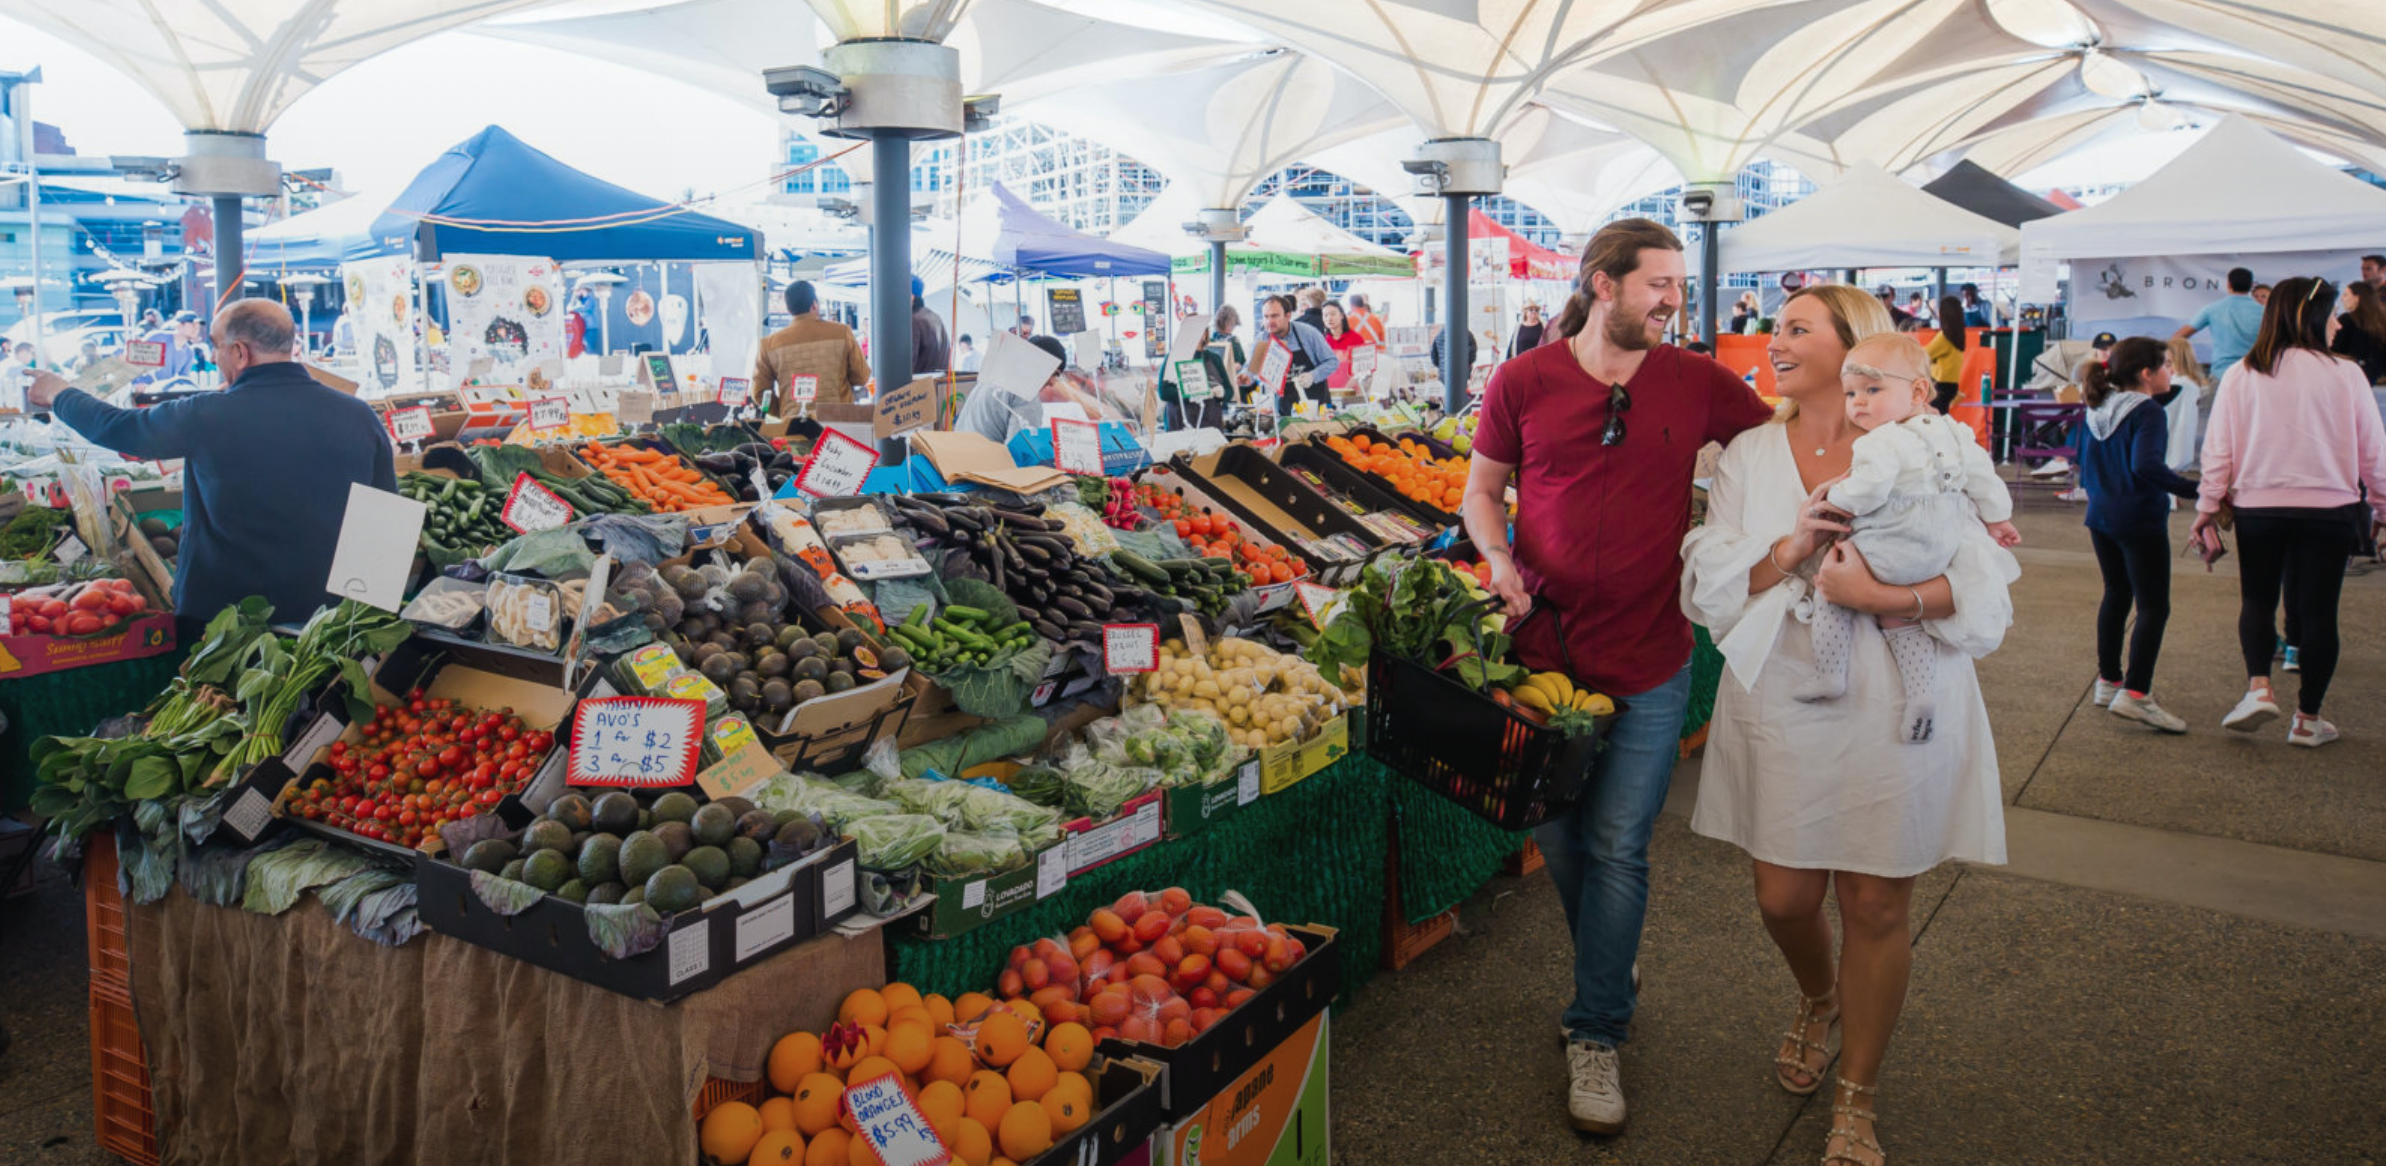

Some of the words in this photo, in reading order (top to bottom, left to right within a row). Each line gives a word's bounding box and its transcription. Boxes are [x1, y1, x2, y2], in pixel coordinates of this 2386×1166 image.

[596, 711, 642, 728] AVO'S
[614, 730, 632, 742] for
[642, 729, 672, 751] $2
[583, 754, 601, 773] 3
[639, 754, 670, 773] $5
[676, 963, 698, 979] CLASS
[852, 1085, 883, 1109] BLOOD
[1231, 1062, 1274, 1121] apane
[857, 1090, 904, 1122] ORANGES
[871, 1113, 916, 1148] $5.99
[1227, 1103, 1260, 1151] arms
